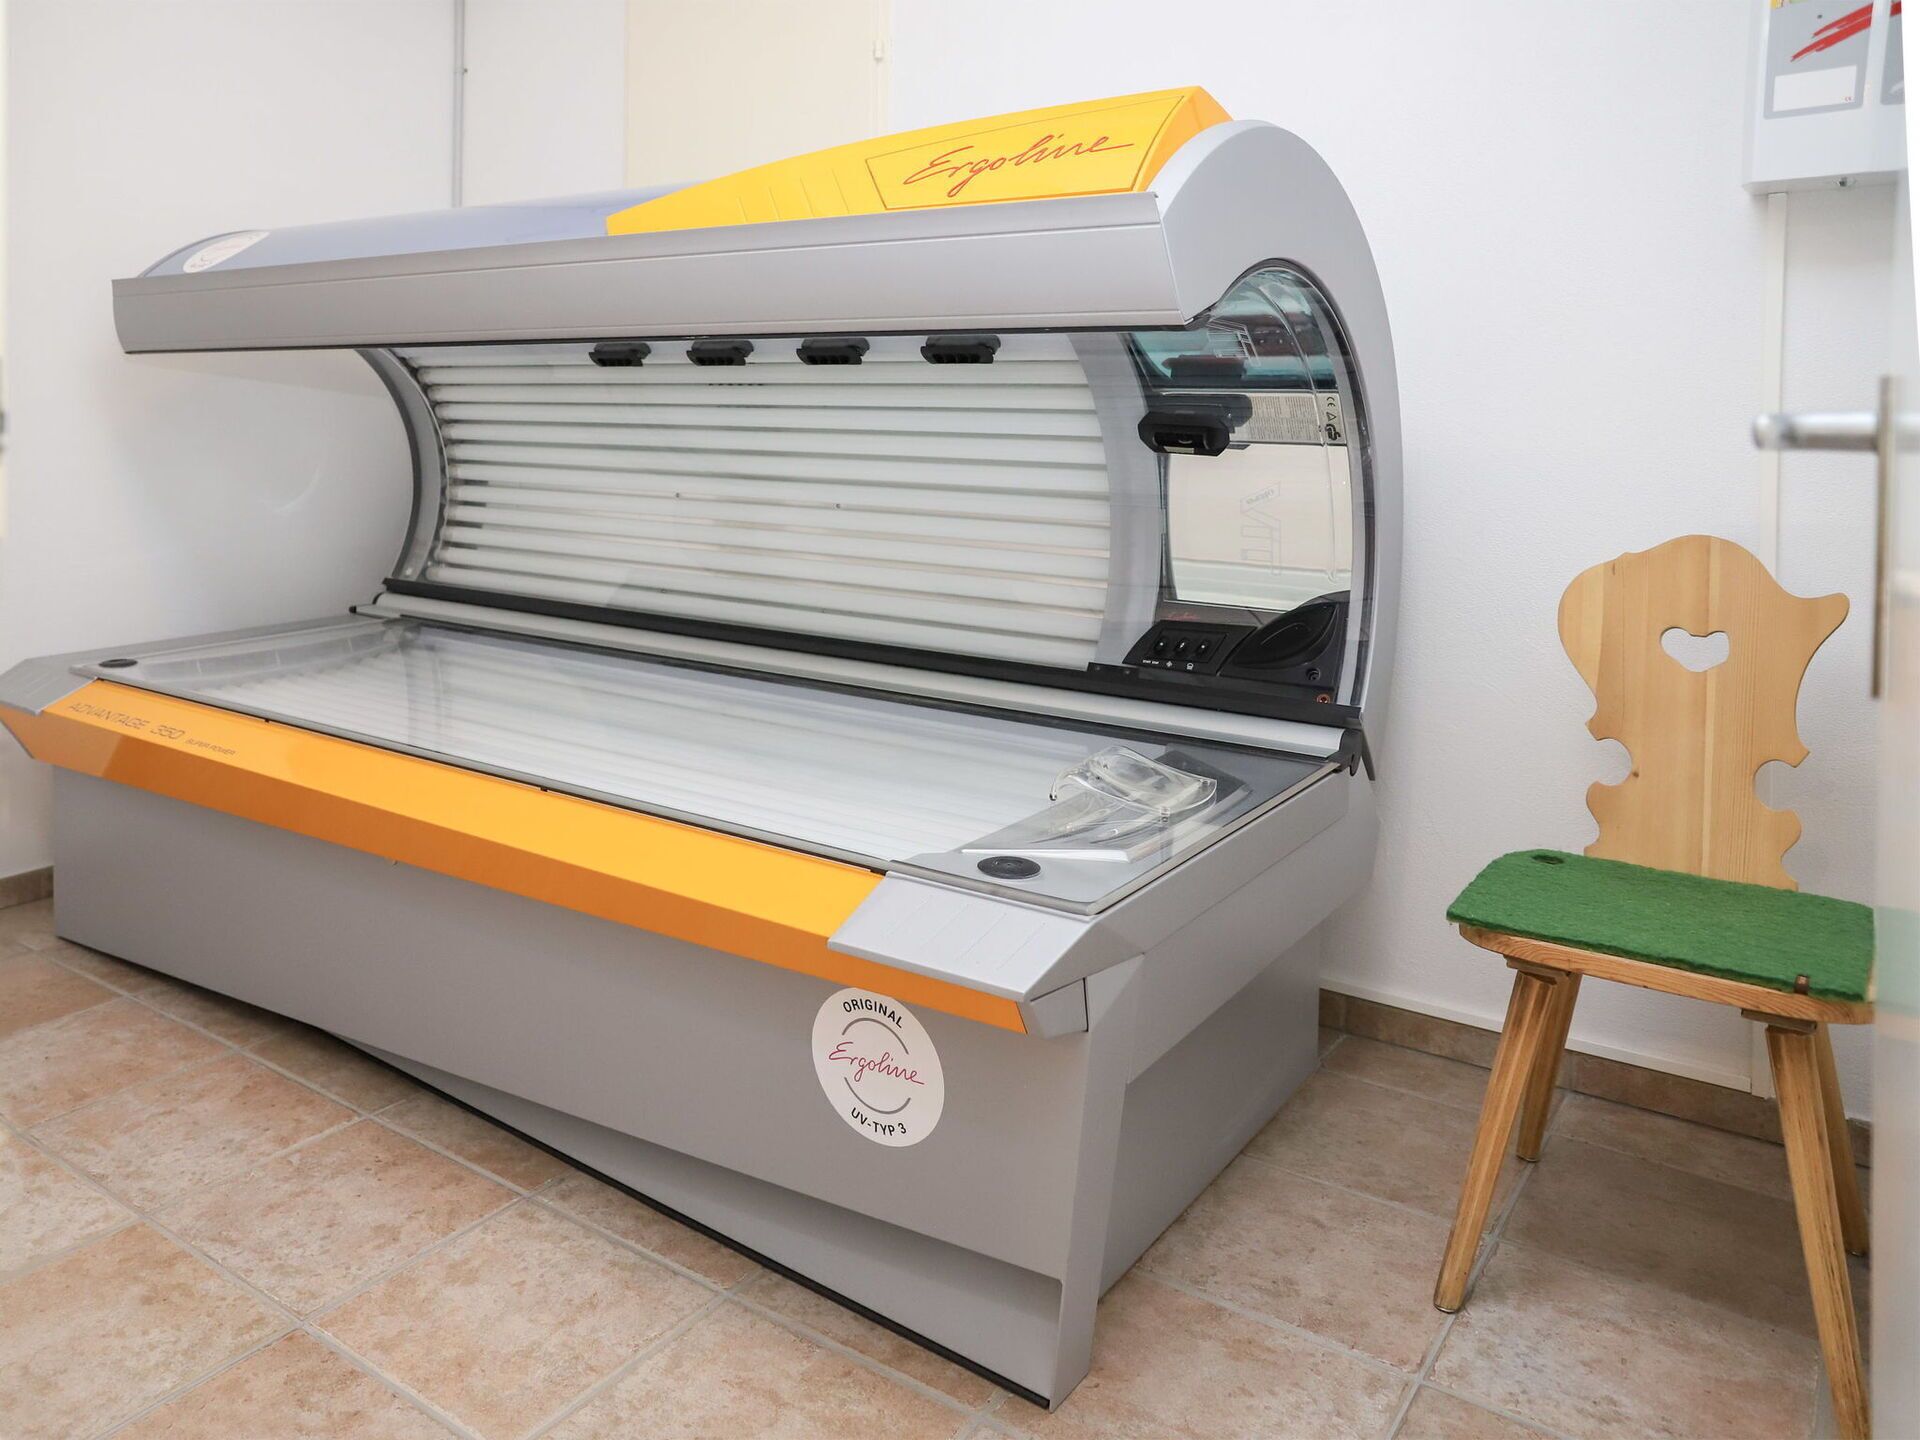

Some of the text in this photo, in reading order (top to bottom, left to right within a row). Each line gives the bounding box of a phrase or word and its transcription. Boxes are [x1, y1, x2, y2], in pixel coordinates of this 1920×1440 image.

[903, 133, 1135, 198] Ergoline
[68, 702, 150, 730] ADVANTAGE
[150, 724, 186, 740] 350
[843, 998, 902, 1029] ORIGINAL
[828, 1041, 925, 1085] Ergoline
[851, 1107, 907, 1136] UV-TYP 3
